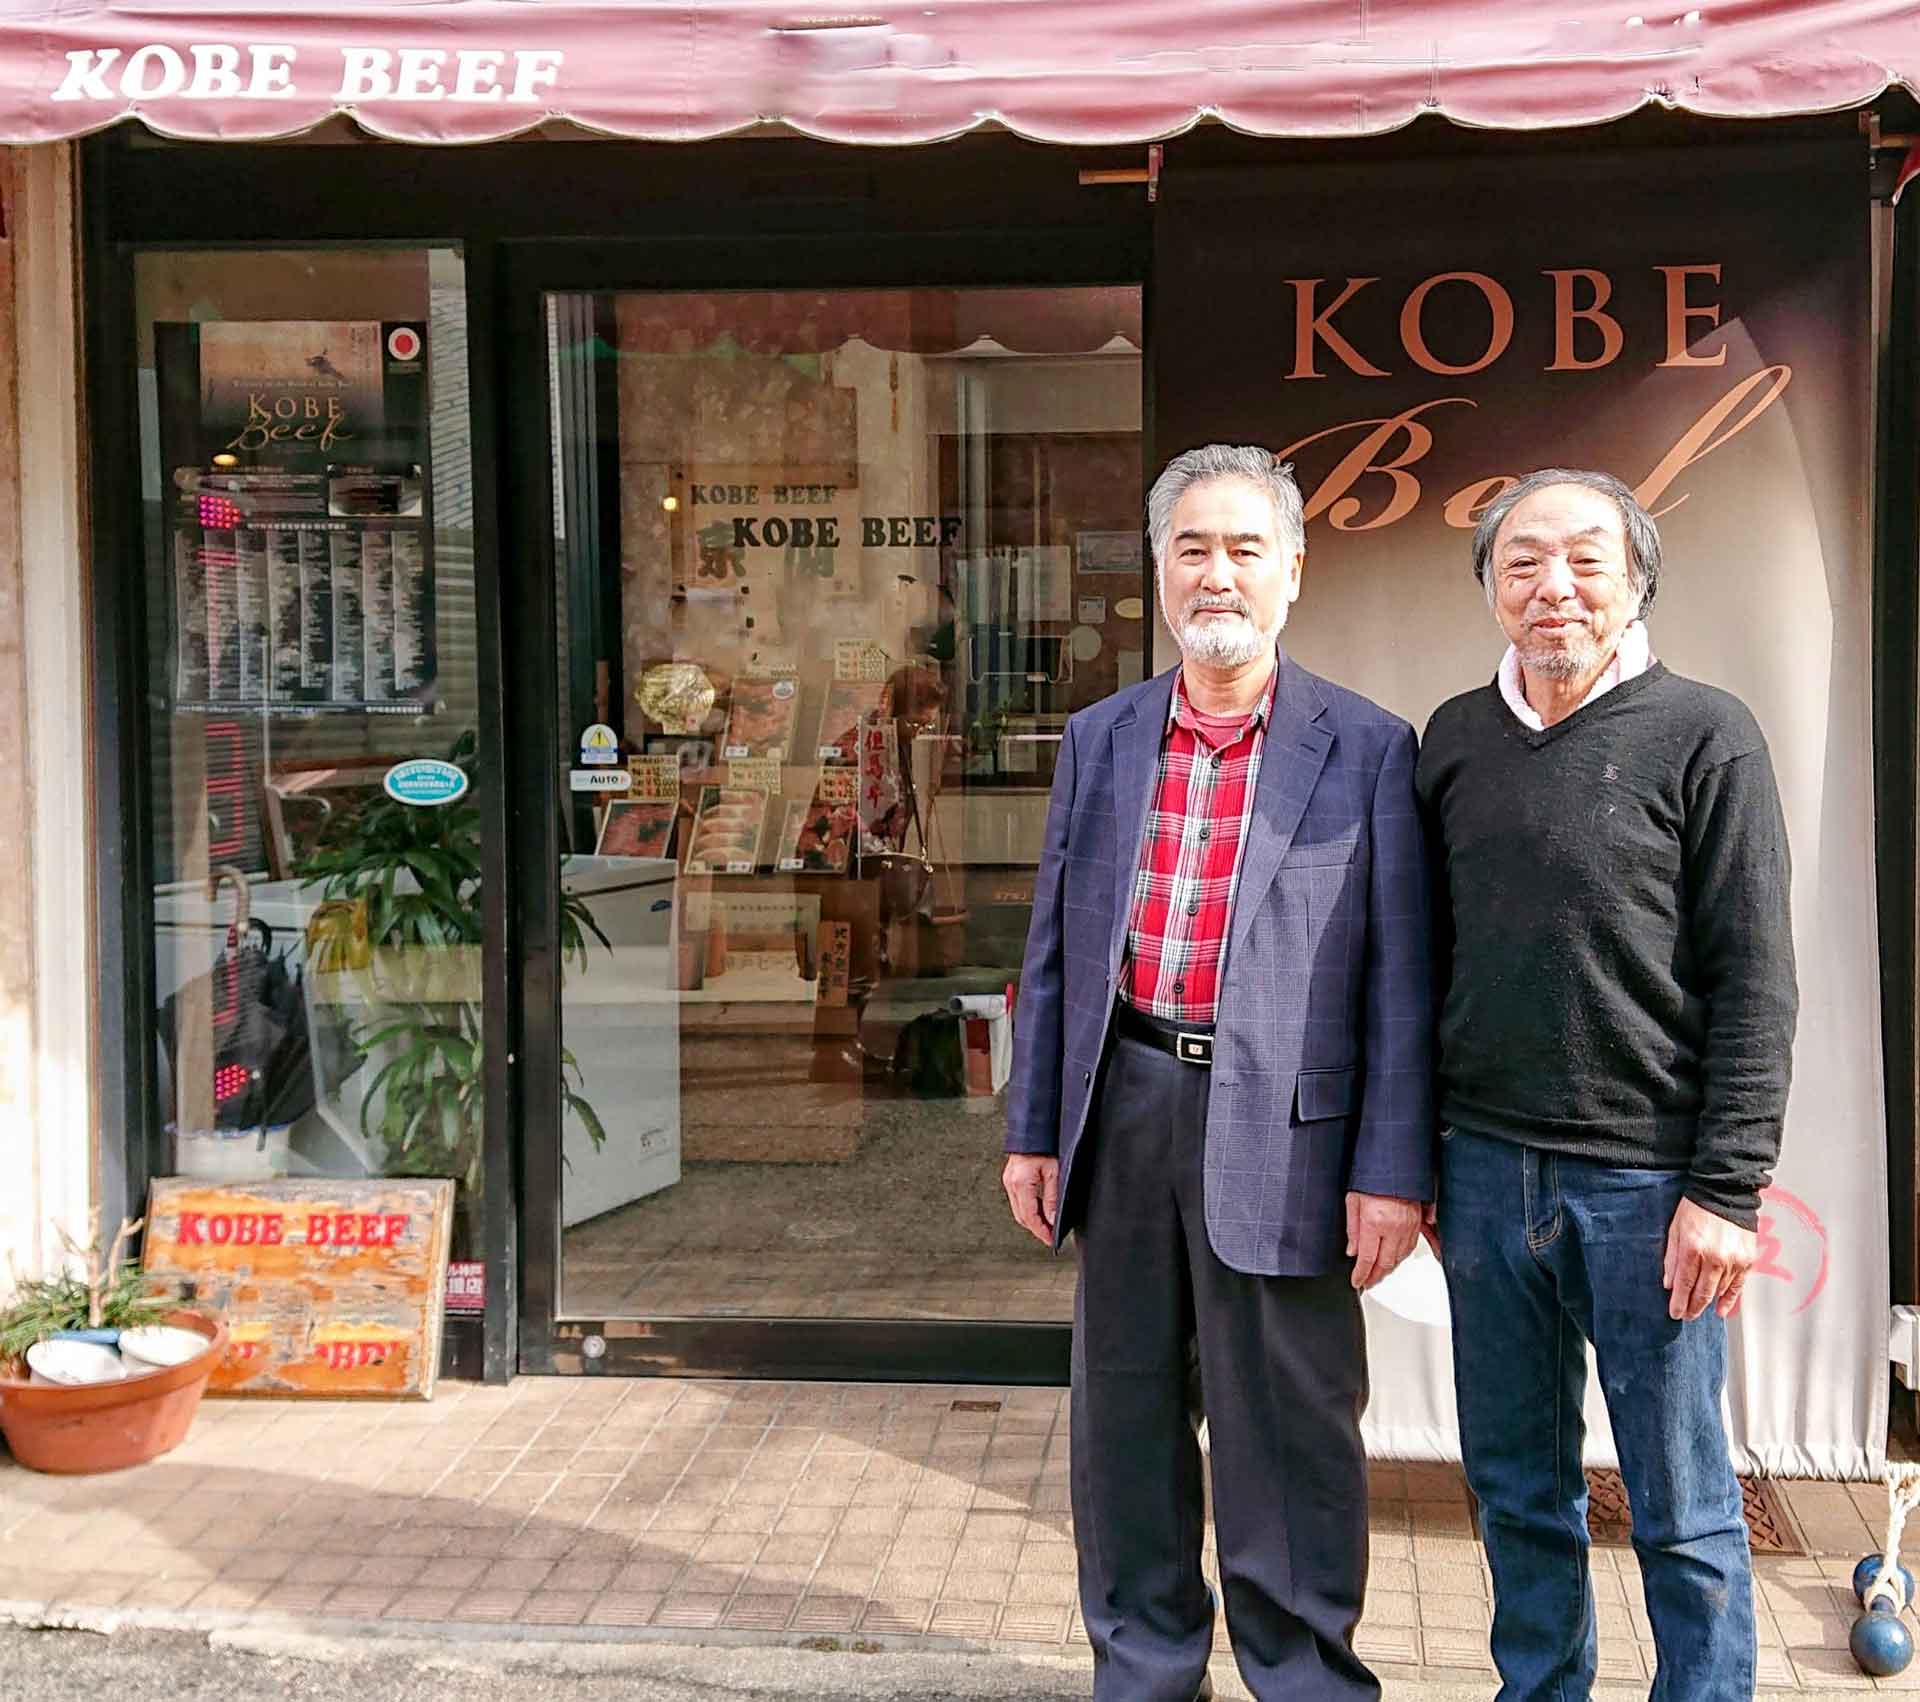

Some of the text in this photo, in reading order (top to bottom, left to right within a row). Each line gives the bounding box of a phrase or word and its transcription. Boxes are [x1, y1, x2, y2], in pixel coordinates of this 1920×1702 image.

[50, 44, 563, 102] KOBE BEEF
[1283, 263, 1728, 379] KOBE
[249, 392, 343, 419] KOBE
[226, 412, 353, 451] Beef
[691, 484, 838, 505] KOBE BEEF
[732, 517, 962, 548] KOBE BEEF
[177, 1212, 410, 1247] KOBE BEEF
